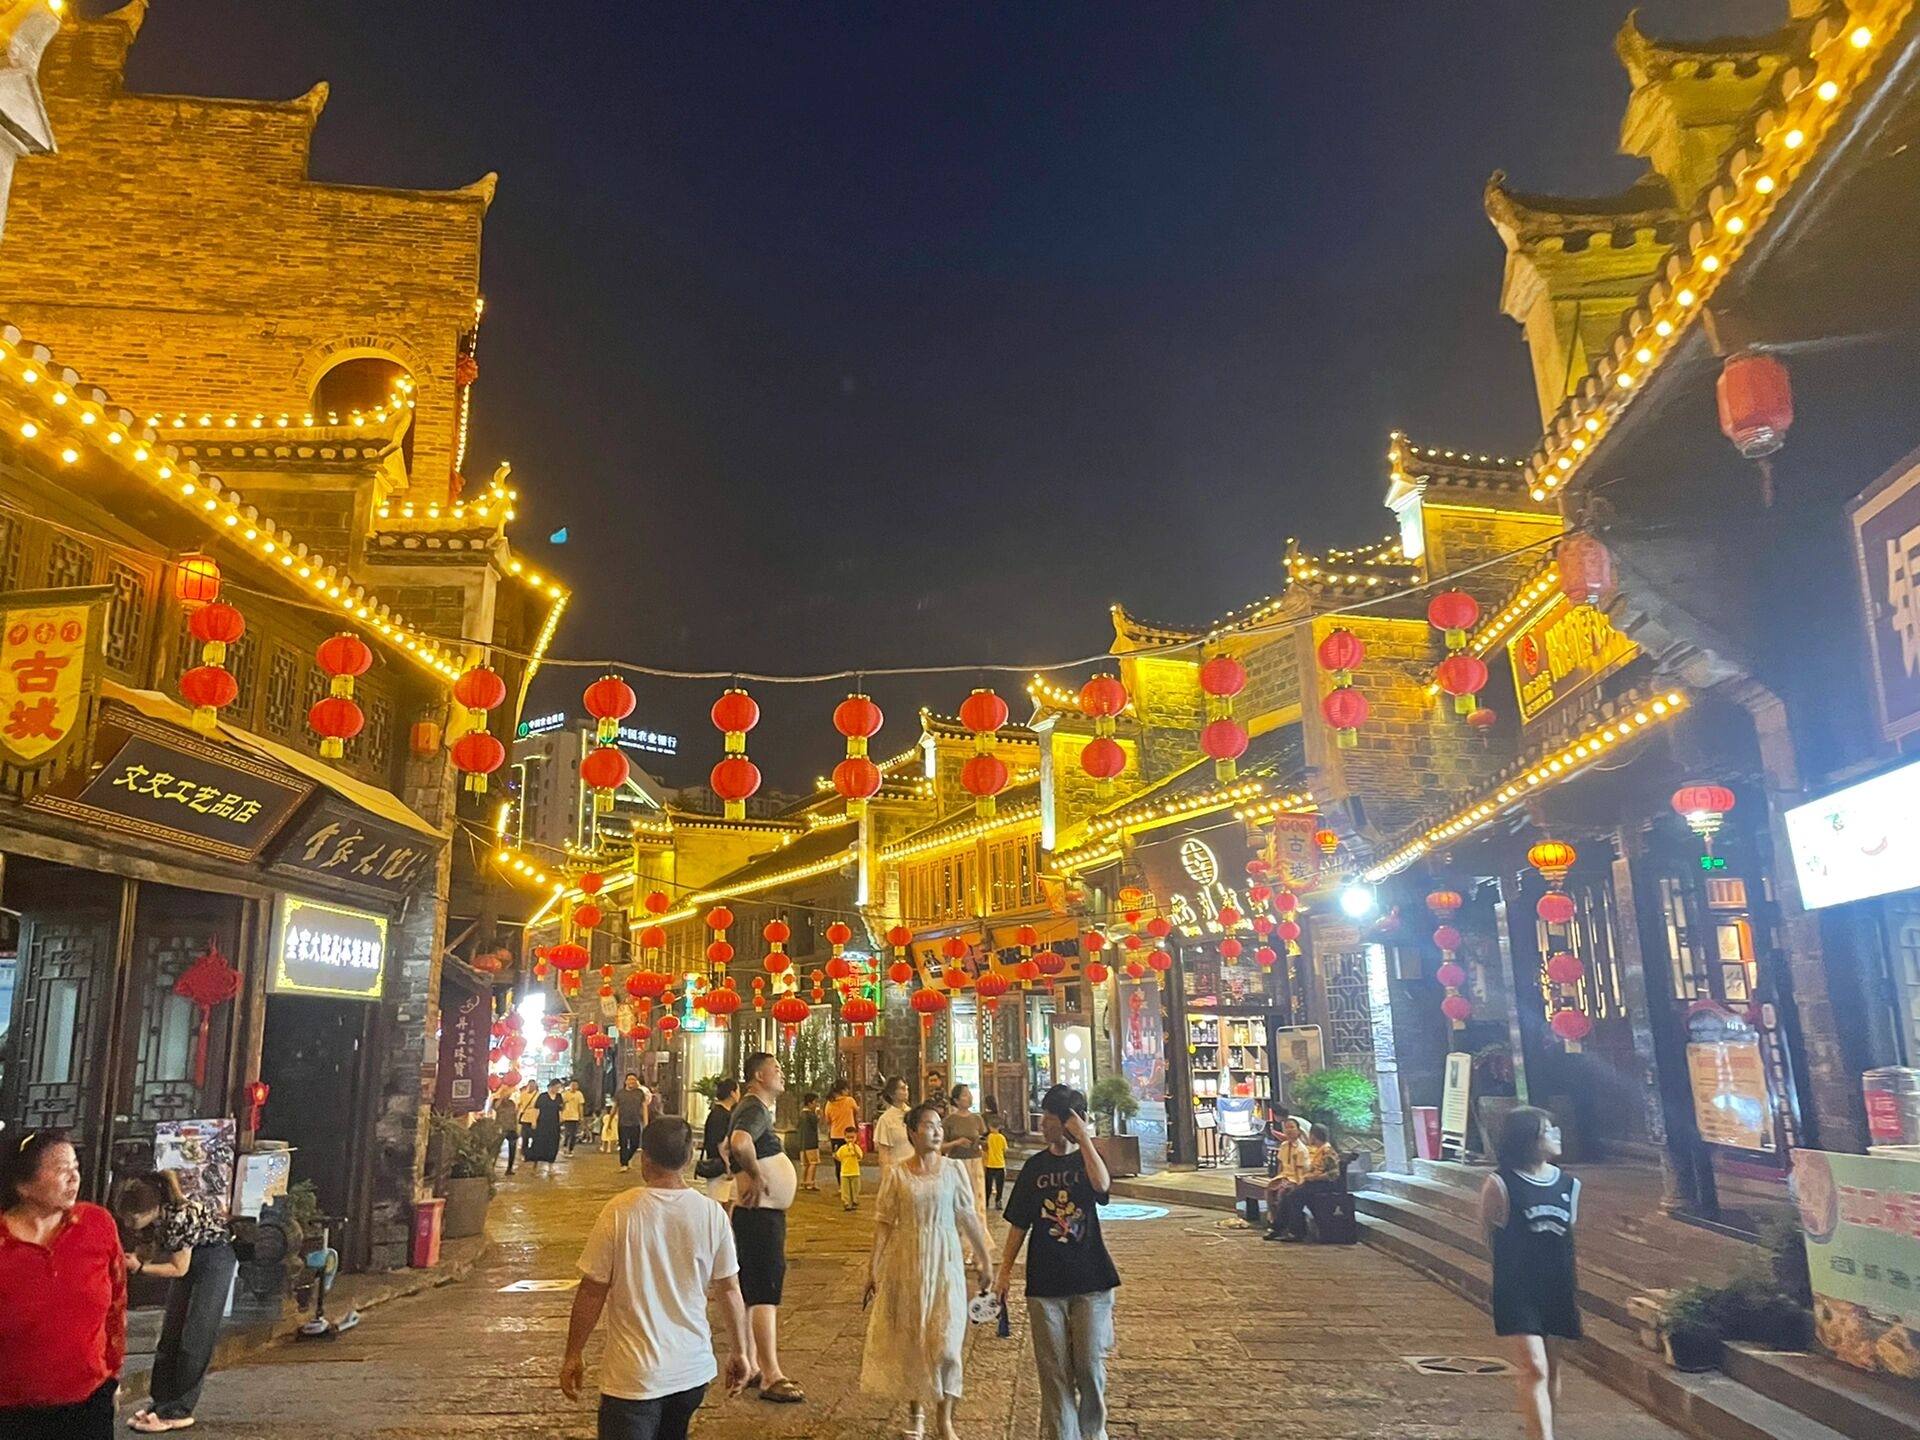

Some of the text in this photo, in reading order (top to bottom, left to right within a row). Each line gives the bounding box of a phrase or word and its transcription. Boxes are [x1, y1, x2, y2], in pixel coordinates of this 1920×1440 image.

[3, 650, 64, 741] 古城
[618, 726, 677, 748] 中国农业银行
[112, 764, 262, 823] 文史工艺品店
